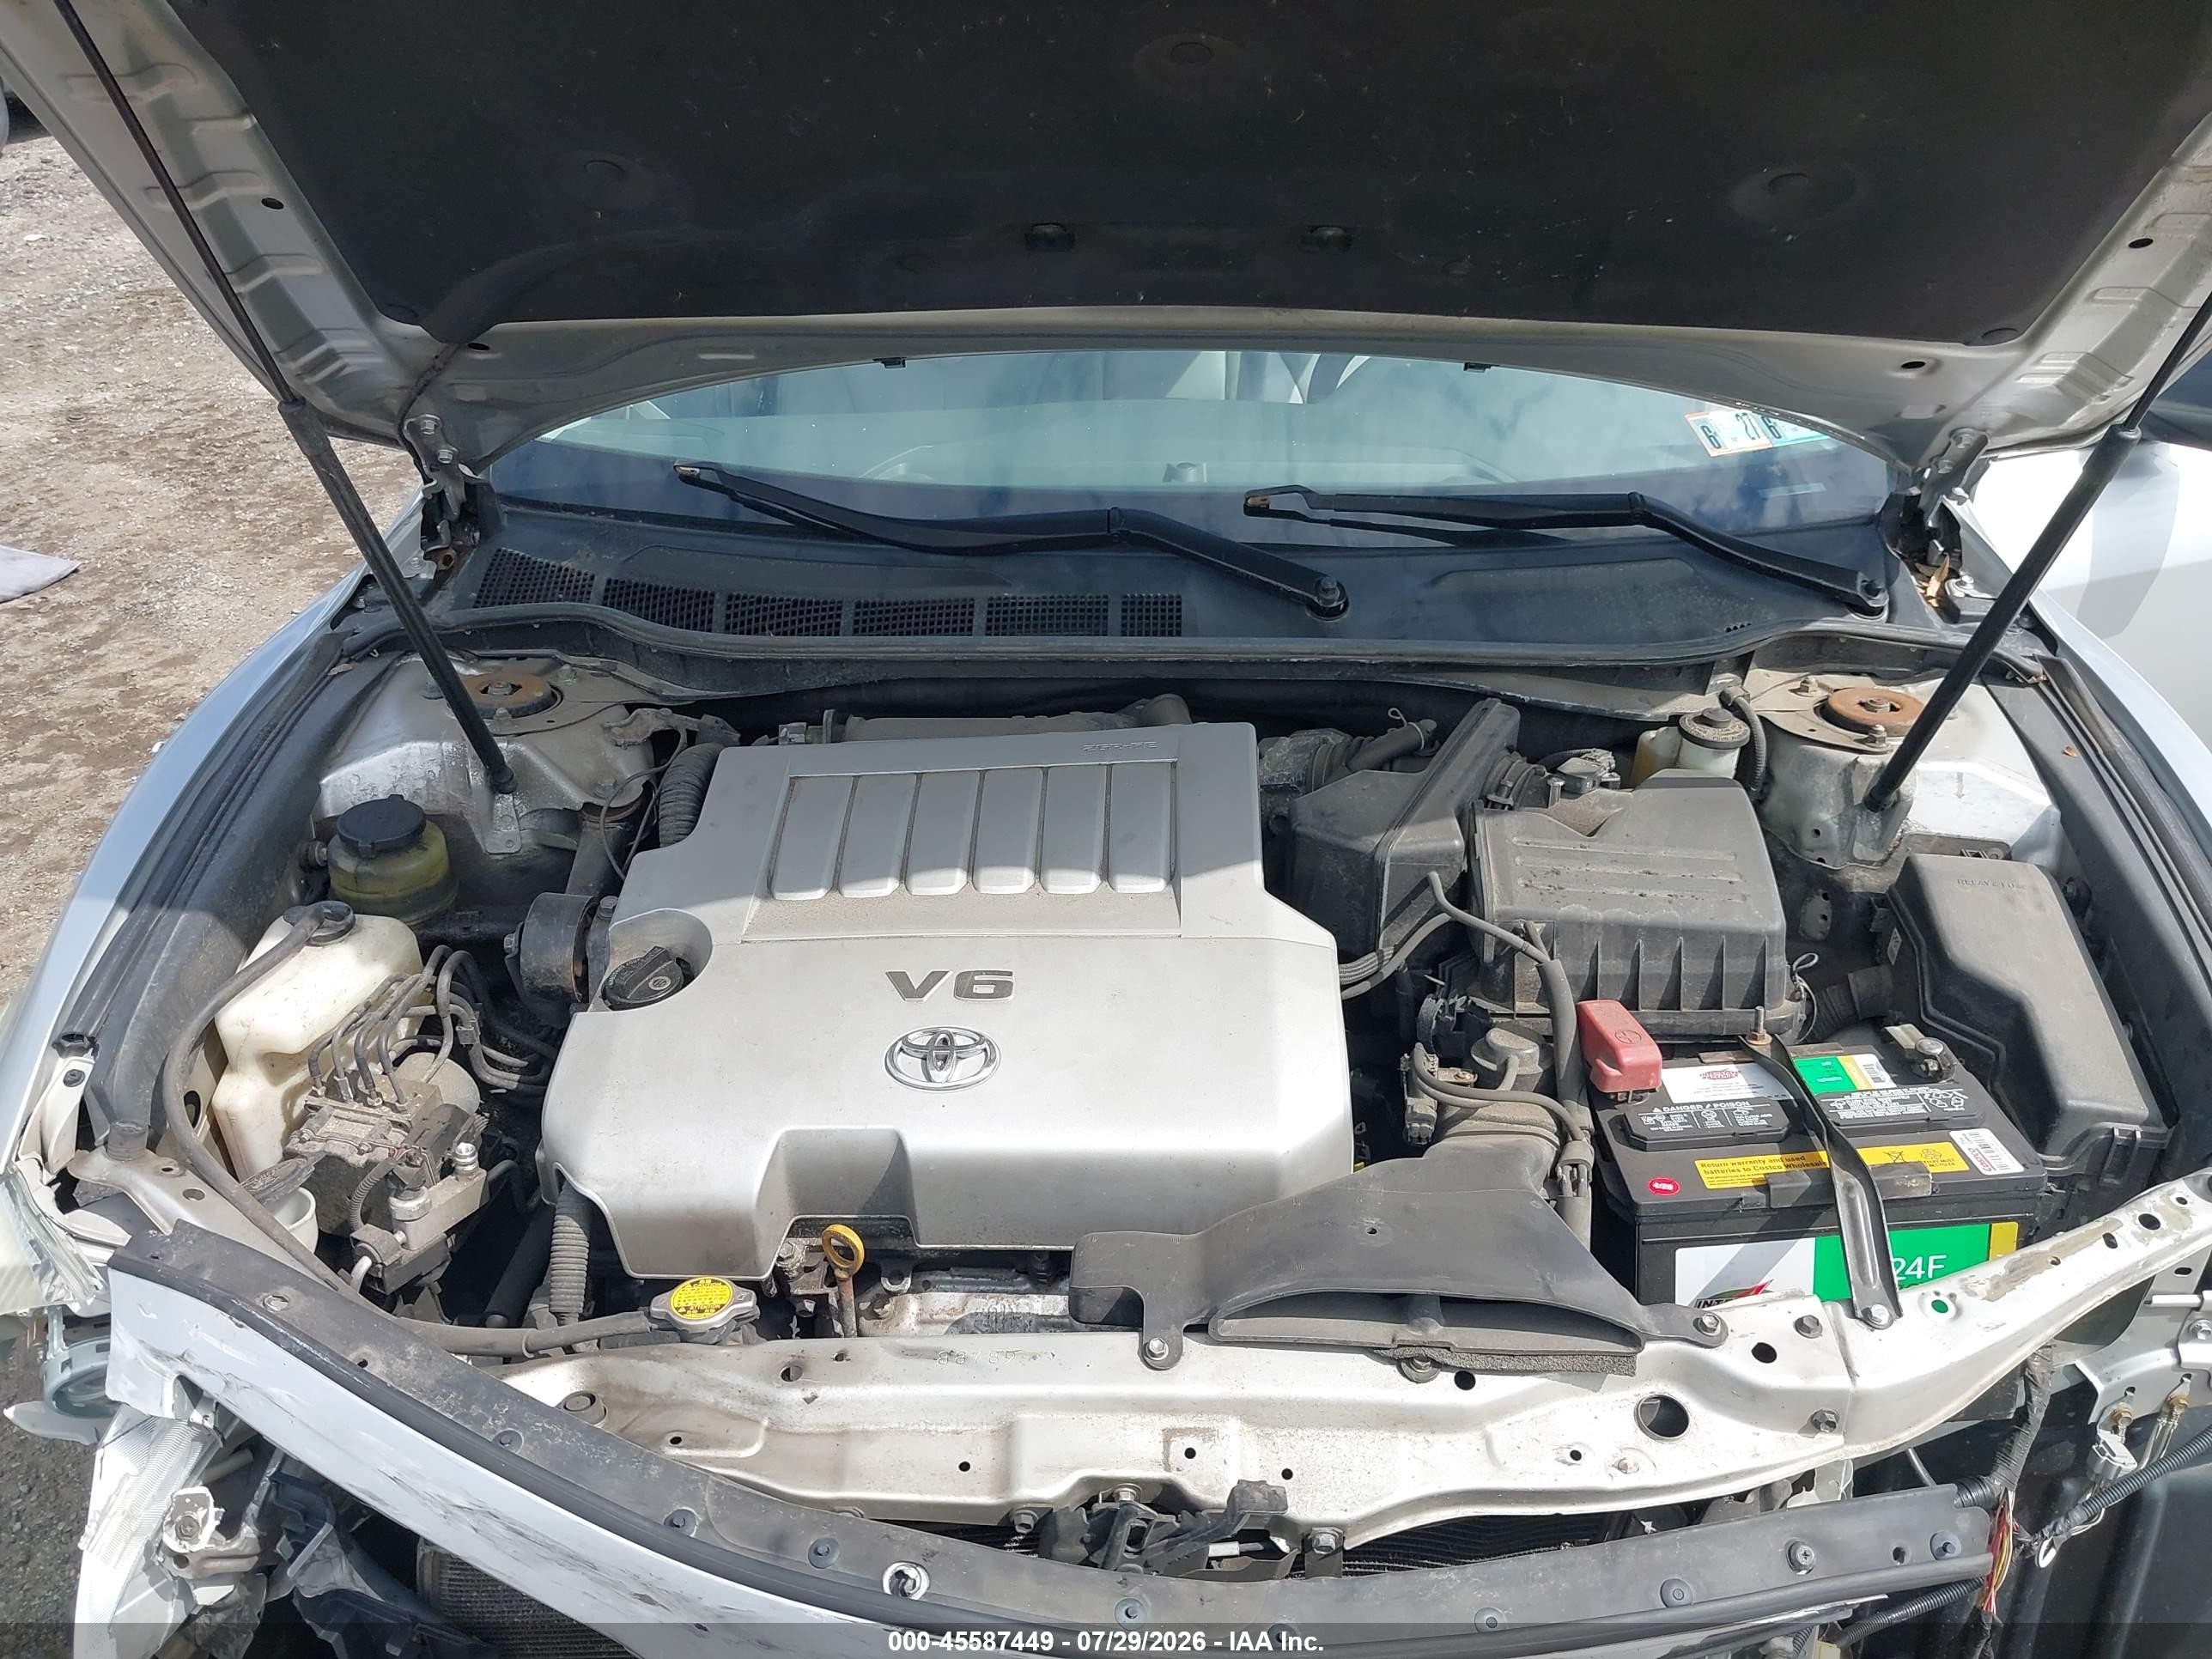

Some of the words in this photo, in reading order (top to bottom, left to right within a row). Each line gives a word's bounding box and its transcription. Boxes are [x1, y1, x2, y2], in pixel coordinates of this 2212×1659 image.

[885, 970, 1015, 1001] V6
[1784, 1160, 1828, 1169] Wholesale
[1893, 1255, 1948, 1279] 24F
